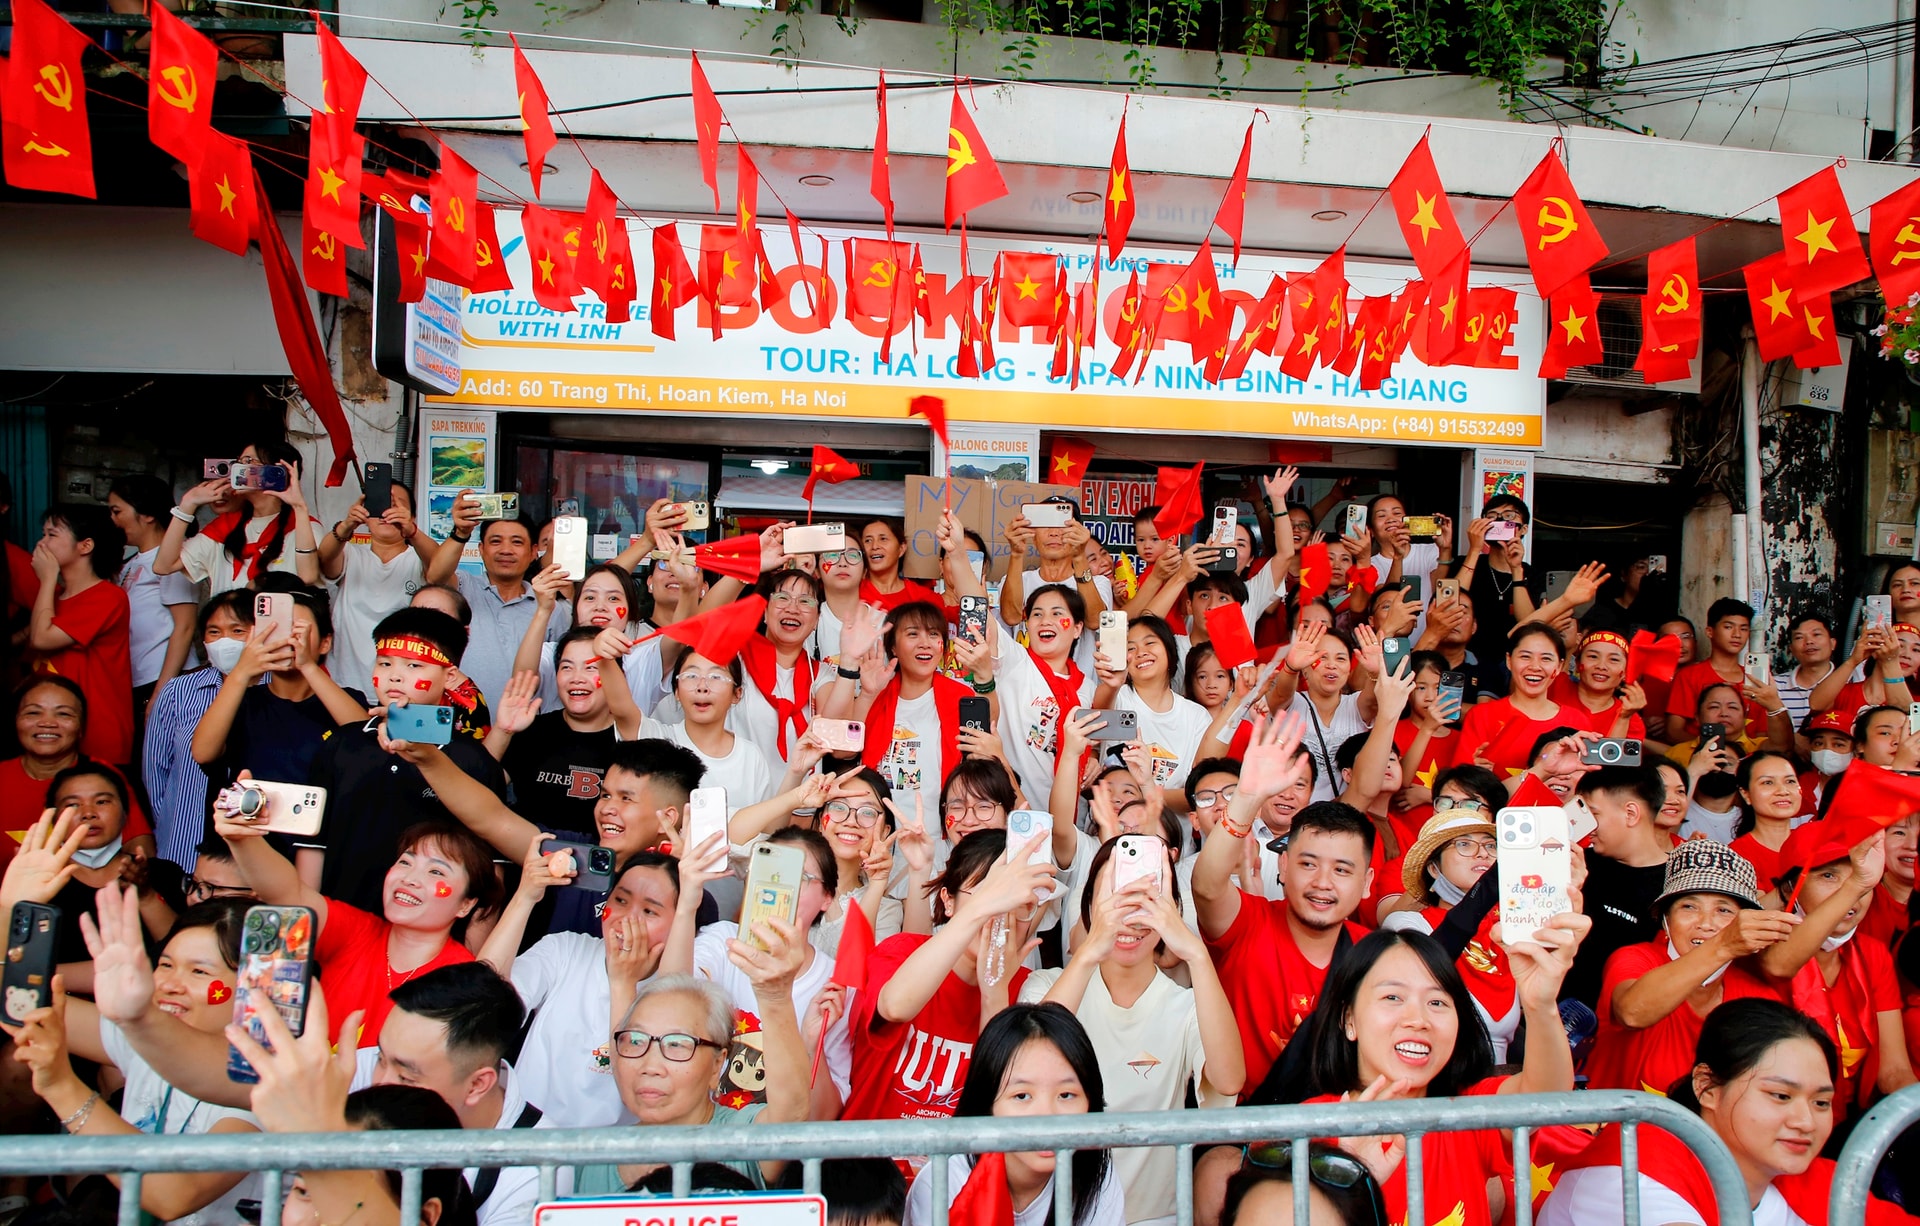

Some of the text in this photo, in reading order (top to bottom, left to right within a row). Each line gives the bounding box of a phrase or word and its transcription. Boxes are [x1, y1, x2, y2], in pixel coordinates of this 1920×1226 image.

[468, 298, 565, 318] HOLID
[418, 321, 431, 345] TAXI
[432, 328, 439, 350] TO
[499, 320, 622, 340] WITH LINH
[760, 346, 860, 374] TOUR:
[873, 351, 917, 378] HA
[1236, 369, 1303, 395] BINH
[1380, 377, 1468, 403] GIANG
[463, 380, 846, 409] Add: 60 Trang Thi, Hoan Kiem, Ha Noi
[1810, 390, 1828, 401] 619
[431, 419, 449, 432] SAPA
[1292, 411, 1525, 437] WhatsApp: (+84) 915532499
[948, 440, 1028, 452] HALONG CRUISE
[1671, 851, 1736, 876] DIOR
